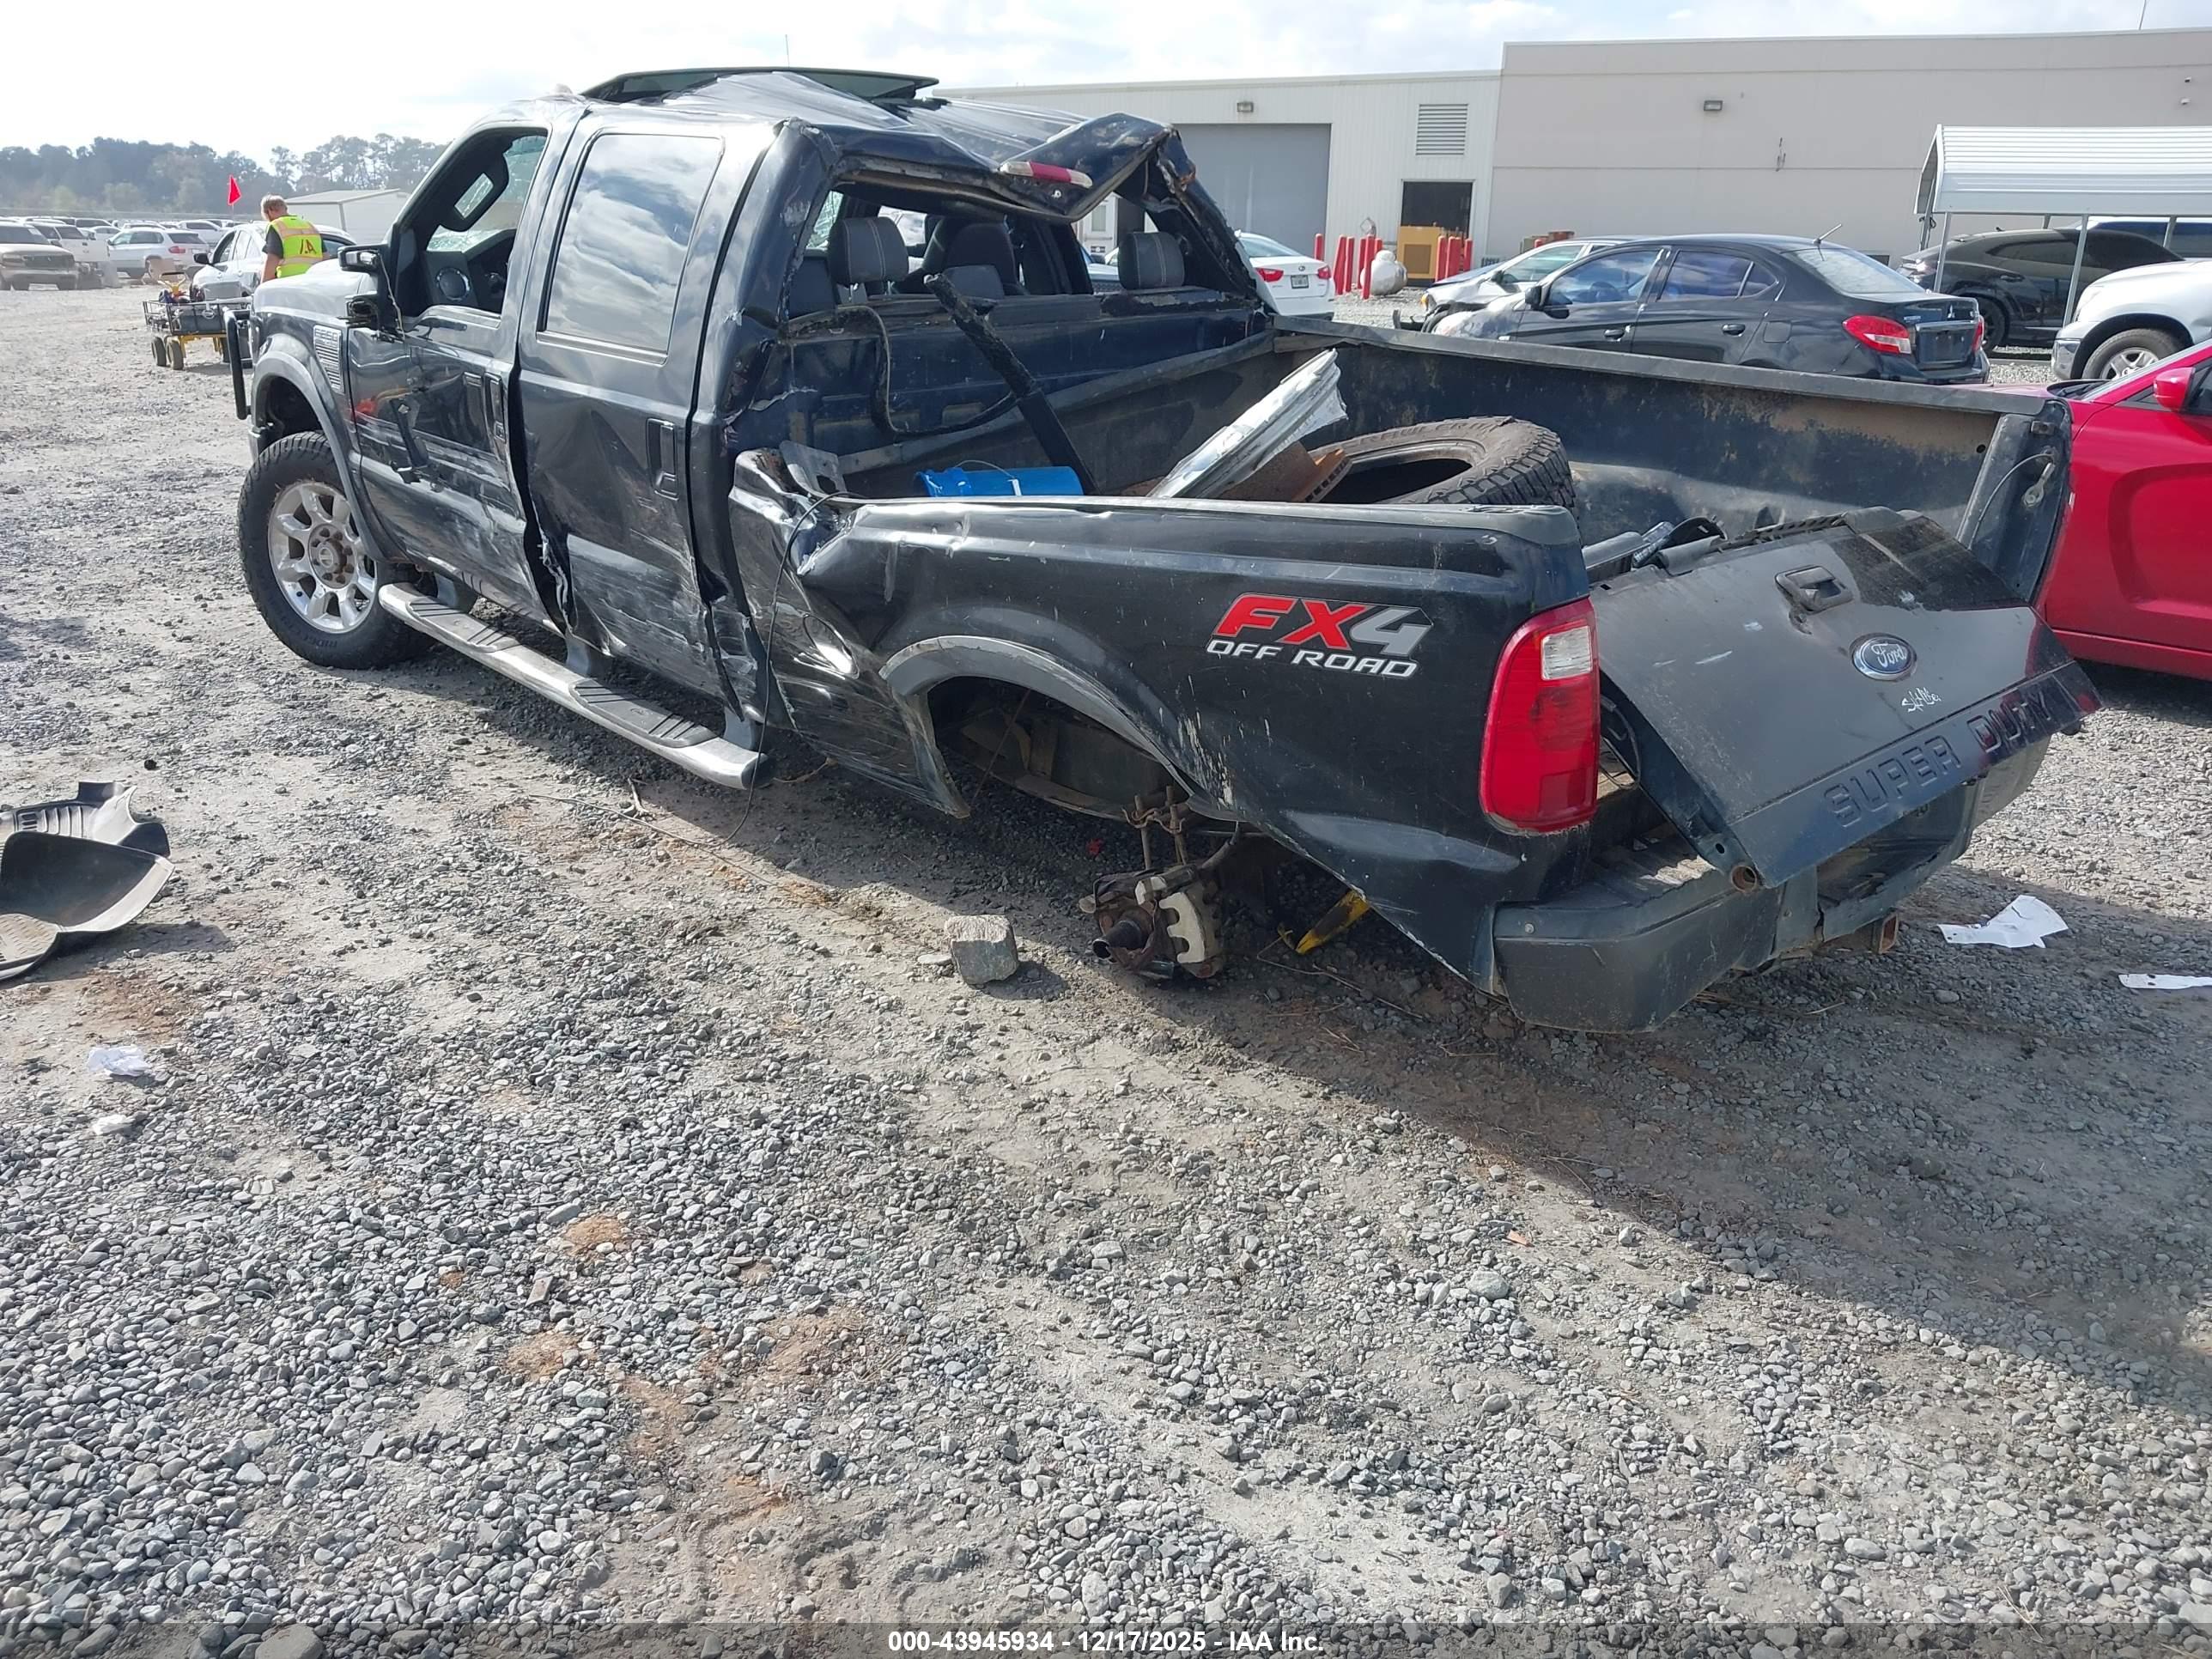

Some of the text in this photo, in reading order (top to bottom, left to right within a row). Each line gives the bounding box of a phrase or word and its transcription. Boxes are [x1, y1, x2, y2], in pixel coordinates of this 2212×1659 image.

[1212, 592, 1433, 658] FX4
[1206, 639, 1419, 678] OFF ROAD
[1871, 643, 1907, 668] Ford
[1823, 689, 2052, 828] SUPER DUTY
